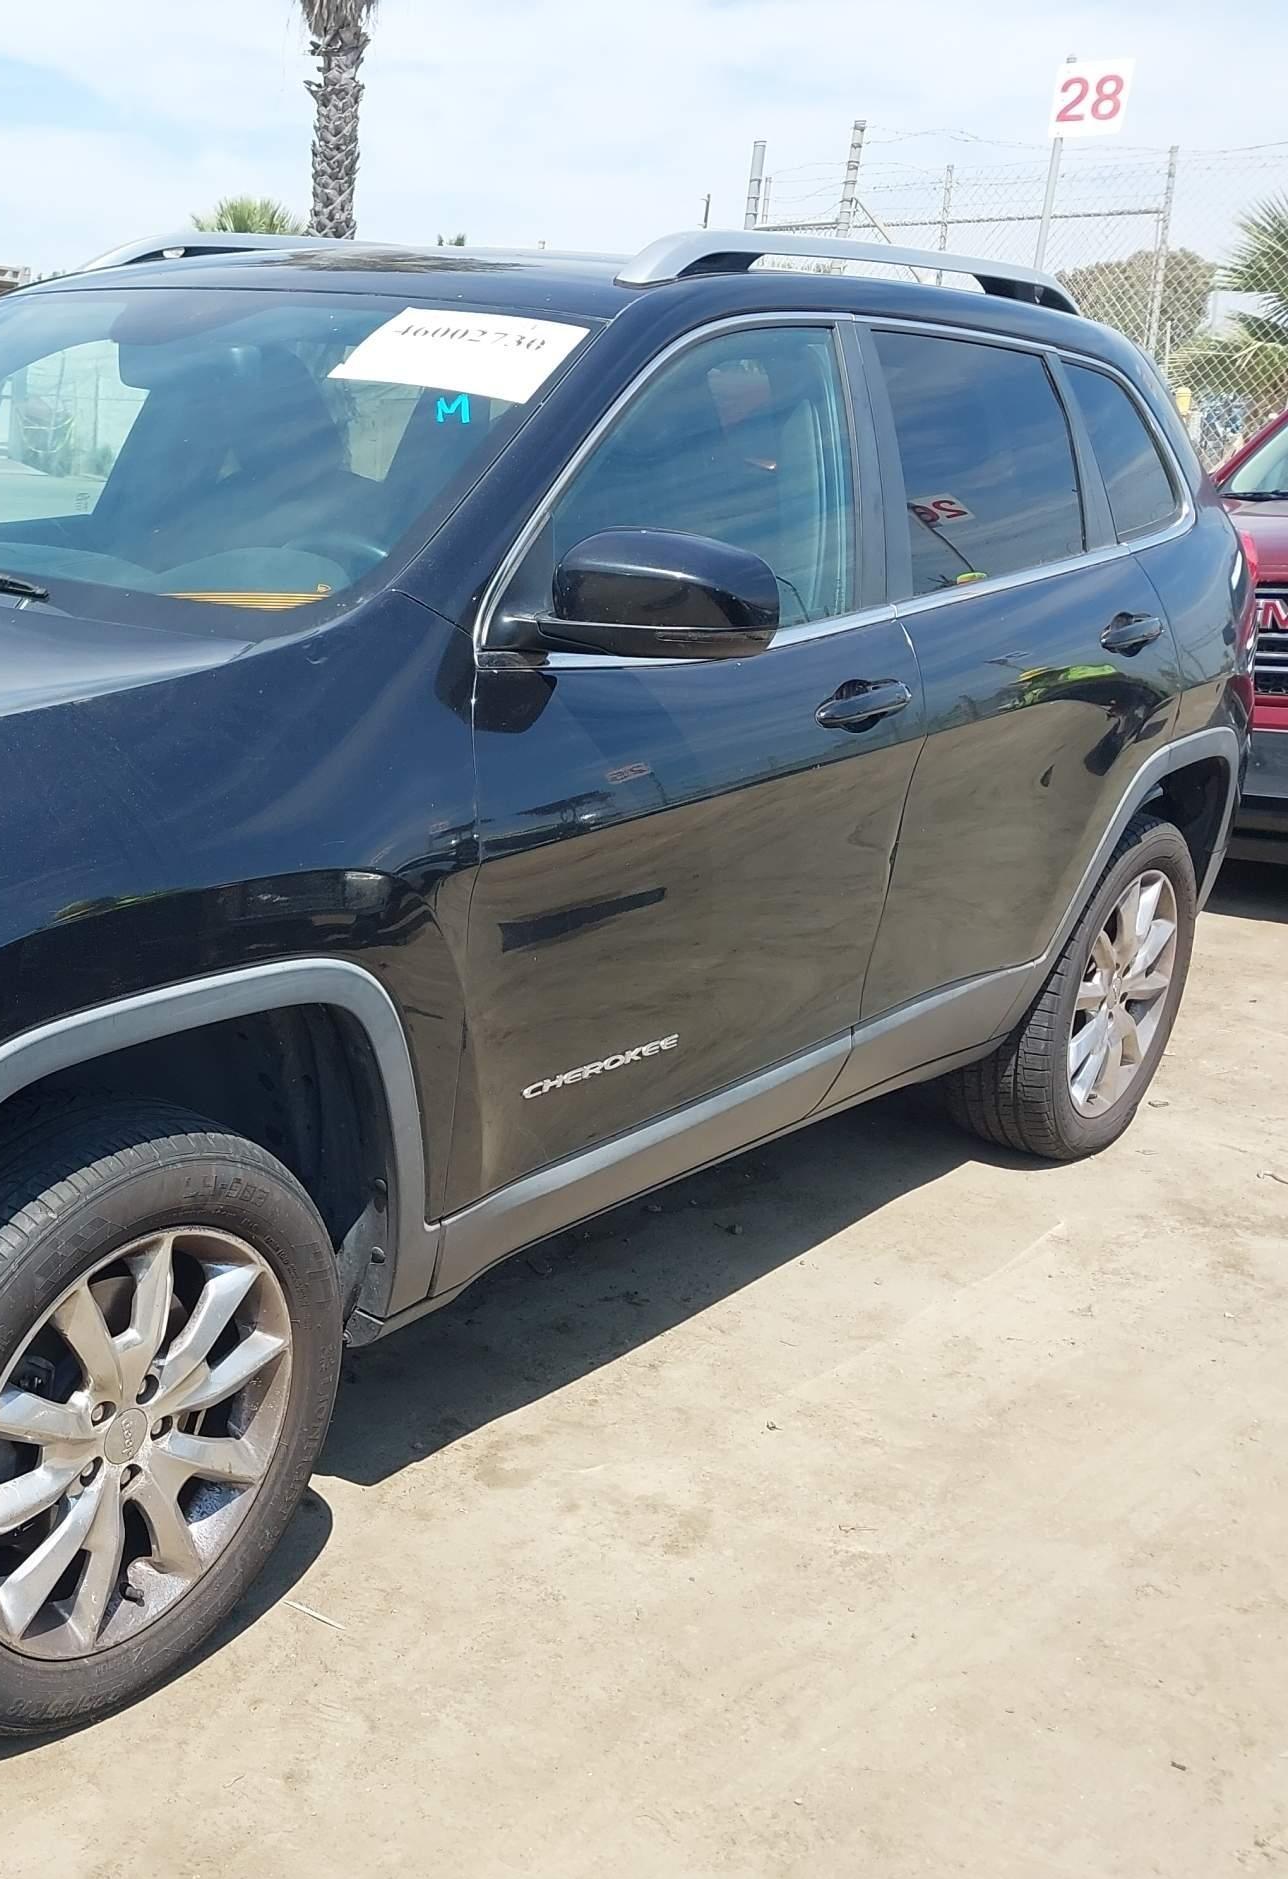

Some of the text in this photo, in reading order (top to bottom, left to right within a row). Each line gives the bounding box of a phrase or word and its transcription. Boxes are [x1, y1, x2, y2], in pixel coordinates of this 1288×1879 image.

[1055, 74, 1124, 122] 28
[436, 393, 470, 424] M
[521, 1033, 679, 1099] CHEROKEE
